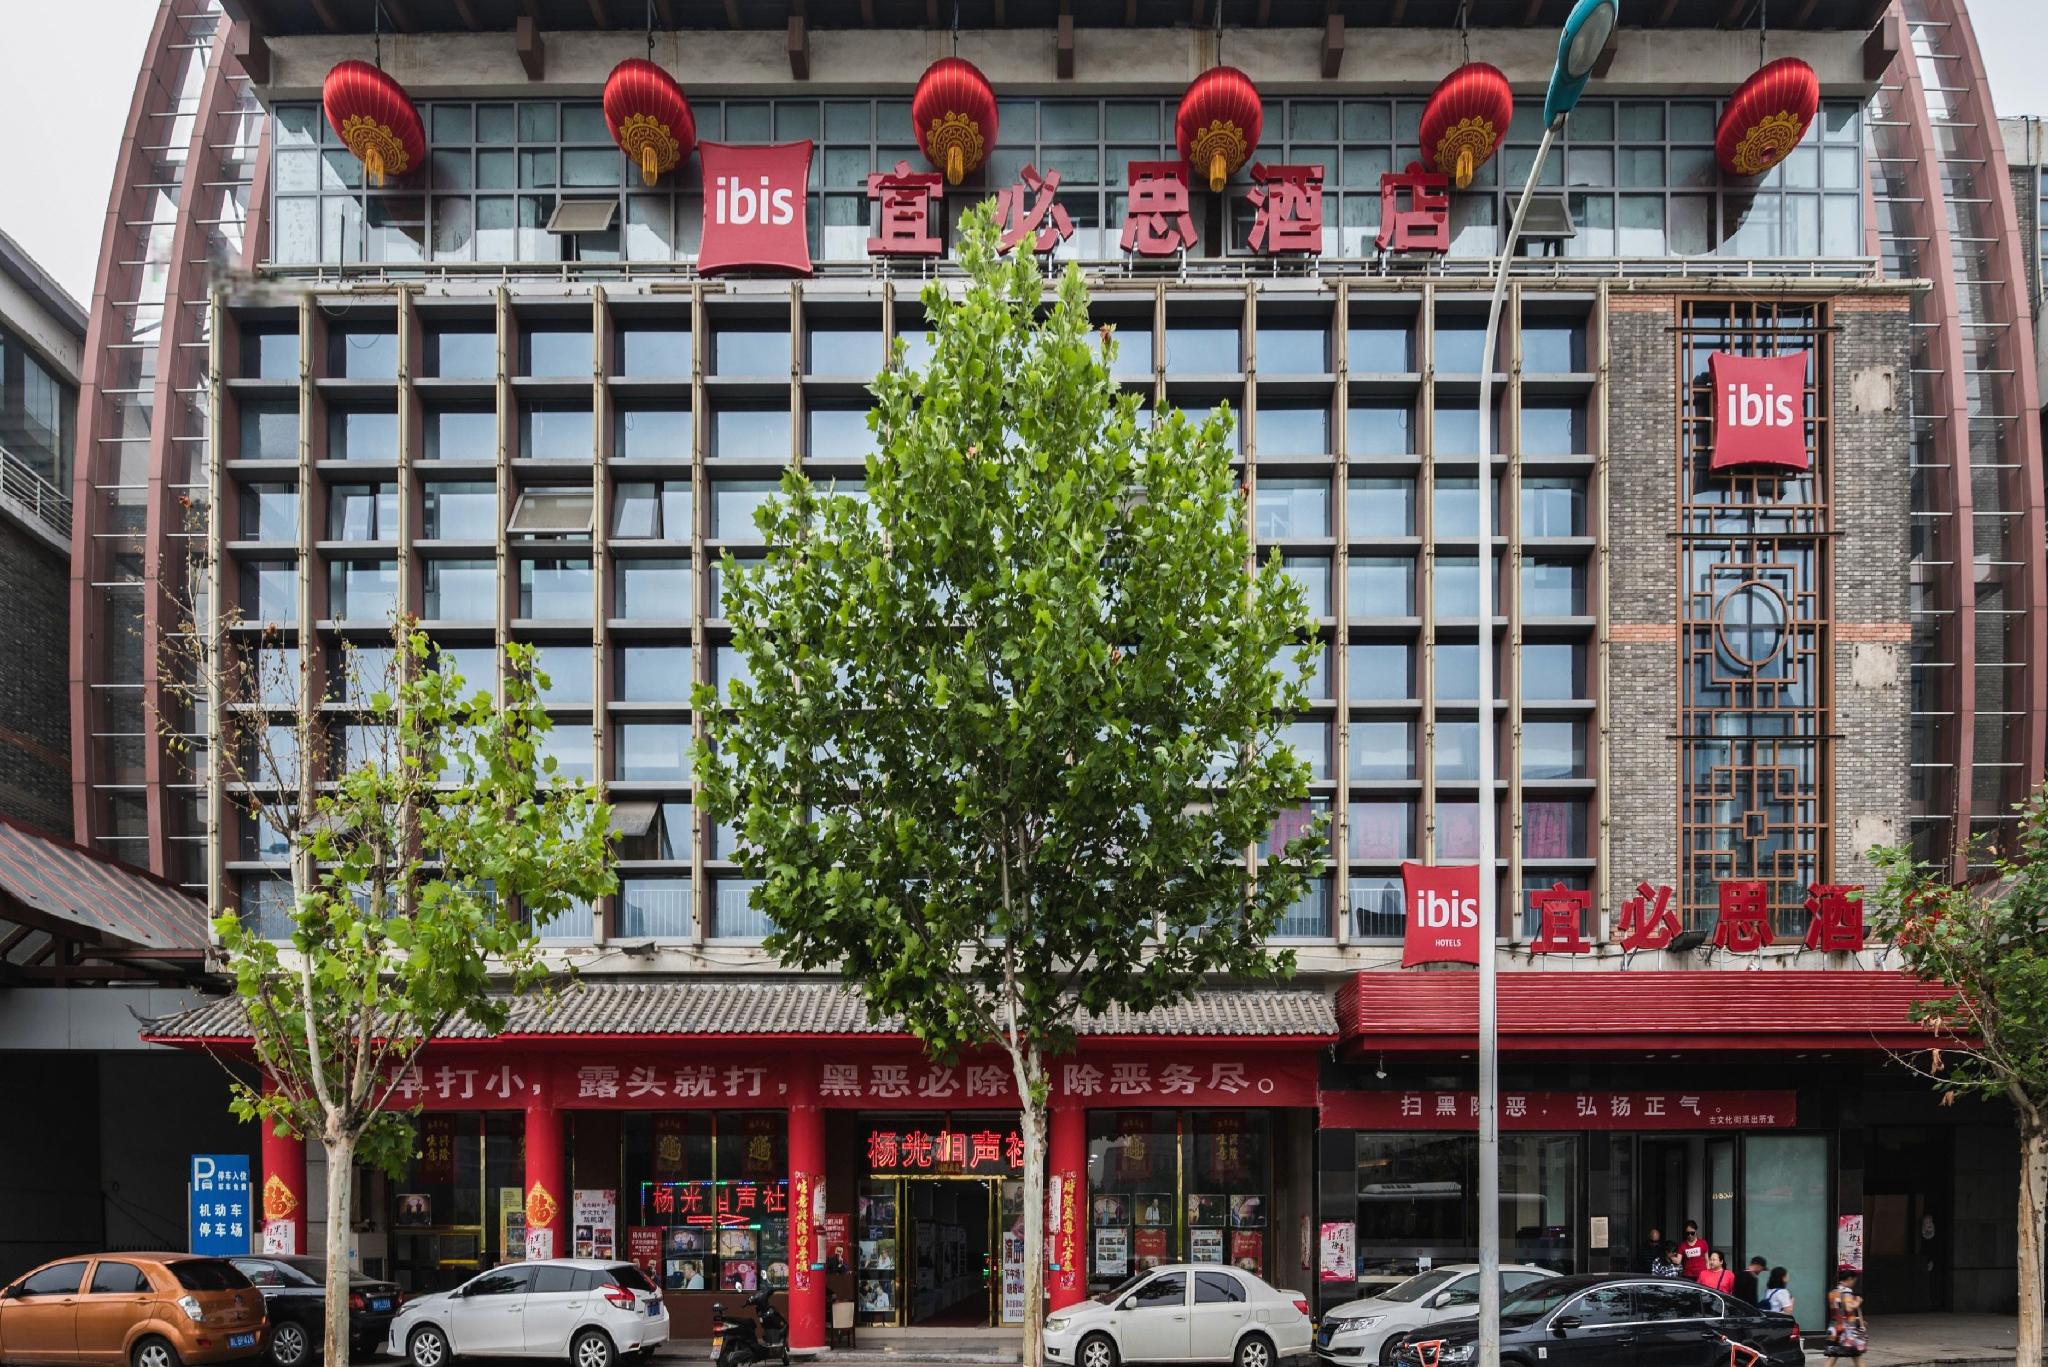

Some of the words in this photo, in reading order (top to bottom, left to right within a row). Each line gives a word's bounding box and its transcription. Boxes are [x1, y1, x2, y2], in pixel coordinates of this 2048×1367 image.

[716, 175, 794, 225] ibis
[866, 160, 1451, 256] 宜必思酒店
[1728, 383, 1794, 427] ibis
[1417, 889, 1478, 928] ibis
[1529, 881, 1953, 954] 宜必思酒
[1435, 938, 1462, 947] HOTELS
[577, 1064, 788, 1099] 露头就打，
[819, 1063, 1011, 1098] 黑恶必除
[1063, 1062, 1276, 1096] 除恶务尽。
[199, 1203, 242, 1217] 机动车
[199, 1222, 243, 1238] 停车场
